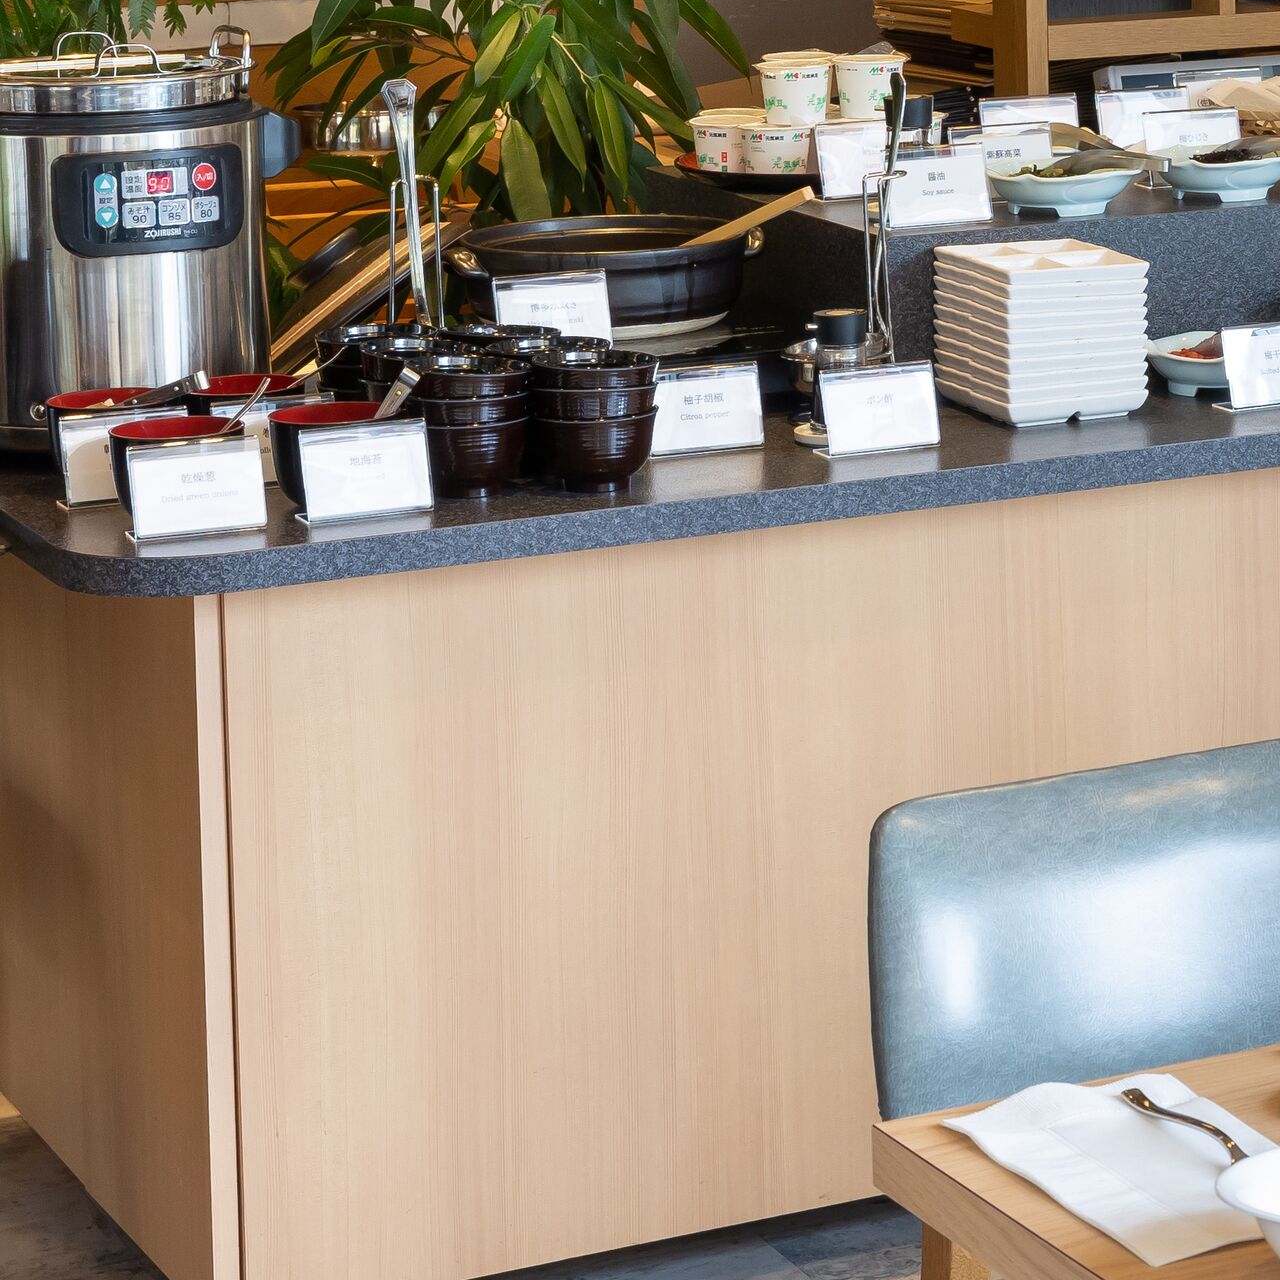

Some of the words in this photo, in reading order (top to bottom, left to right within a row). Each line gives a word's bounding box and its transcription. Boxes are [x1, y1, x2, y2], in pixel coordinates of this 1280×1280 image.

[921, 189, 935, 197] Soy
[127, 206, 150, 215] みそ汁
[162, 203, 186, 213] コンソメ
[168, 211, 181, 221] 85
[200, 208, 213, 219] 80
[132, 214, 147, 224] 90
[144, 227, 182, 240] ZOJIRUSHI
[683, 392, 723, 406] 柚子胡椒
[680, 412, 703, 422] Citron
[161, 494, 184, 505] Dried
[185, 491, 210, 503] green
